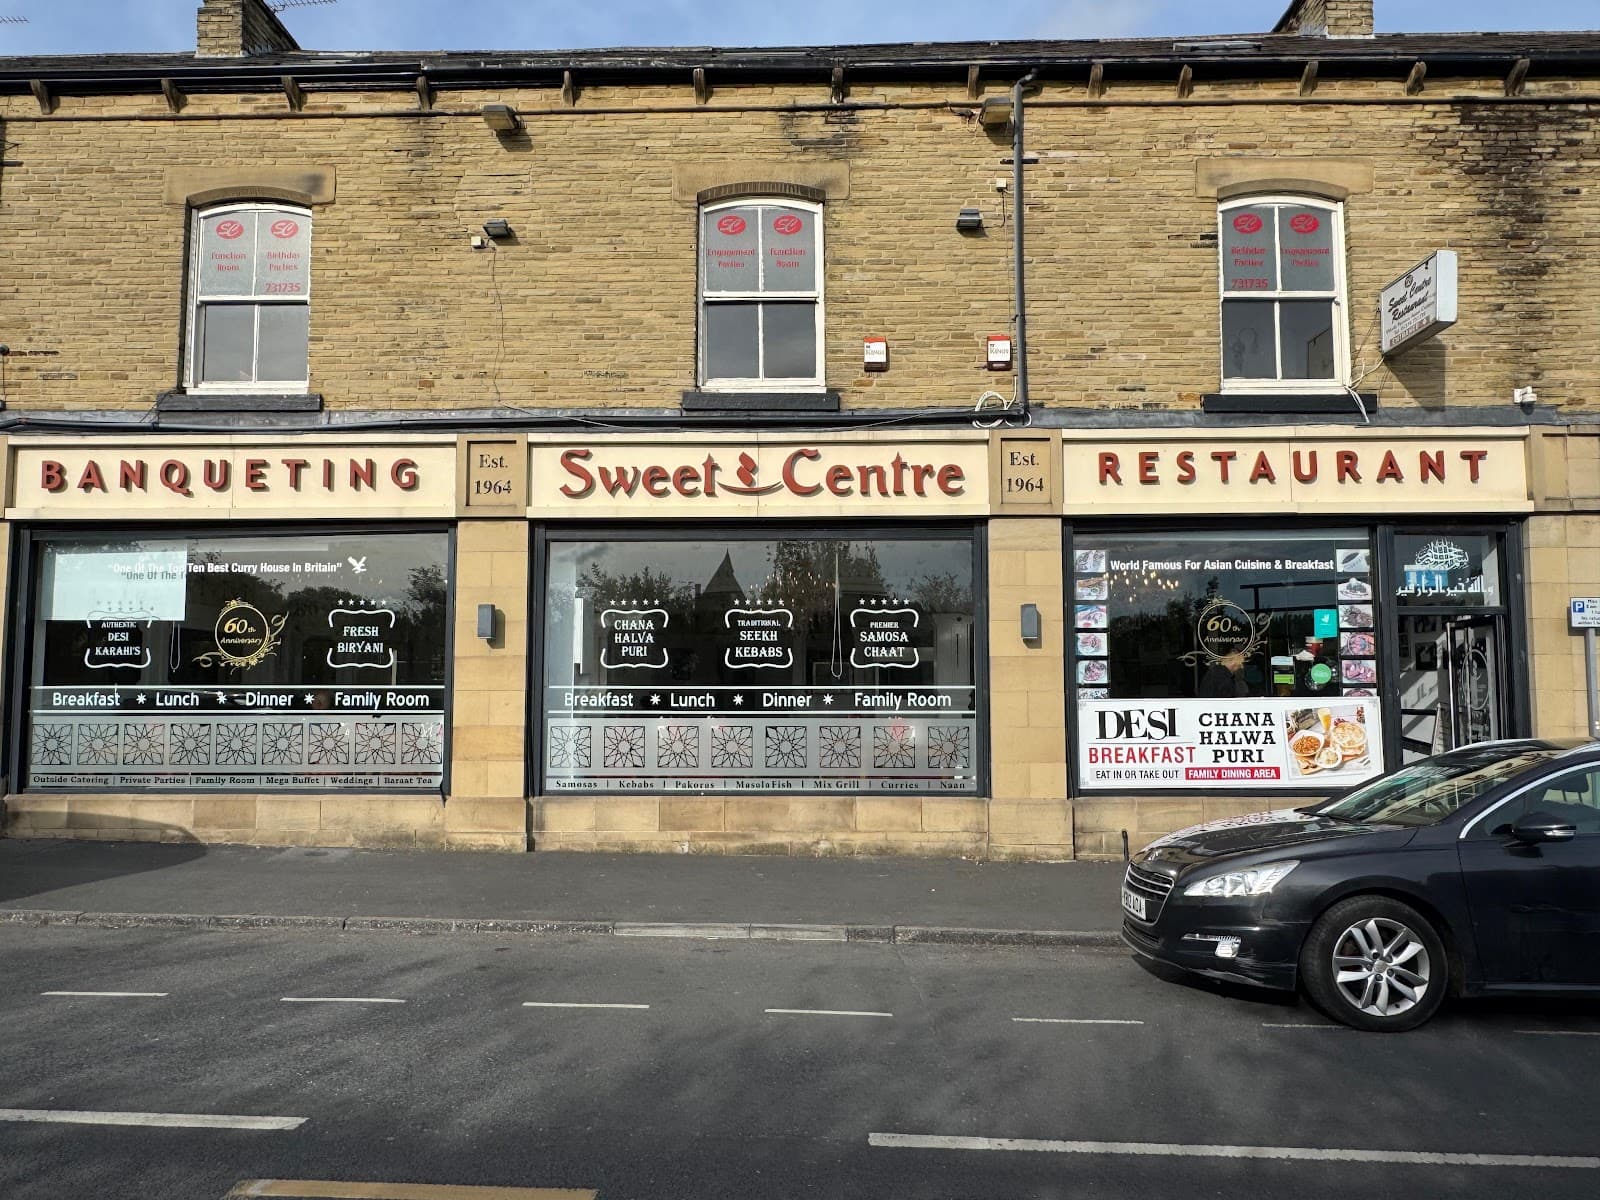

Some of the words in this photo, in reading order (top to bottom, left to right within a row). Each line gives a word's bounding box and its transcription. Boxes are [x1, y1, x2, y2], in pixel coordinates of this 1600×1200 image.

[265, 282, 301, 293] 731735
[479, 454, 509, 469] Est.
[1010, 451, 1040, 466] Est.
[559, 448, 719, 497] Sweet
[782, 448, 965, 497] Centre
[1099, 449, 1489, 485] RESTAURANT
[41, 458, 419, 496] BANQUETING
[475, 480, 512, 494] 1964
[1008, 477, 1044, 492] 1964
[187, 562, 205, 573] Ten
[207, 562, 229, 573] Best
[231, 562, 258, 575] Curry
[260, 562, 290, 573] House
[292, 562, 302, 573] In
[1110, 560, 1140, 570] World
[1142, 560, 1182, 570] Famous
[1184, 560, 1201, 570] For
[1203, 560, 1232, 570] Asian
[1234, 559, 1271, 570] Cuisine
[1273, 560, 1283, 570] &
[1285, 559, 1334, 570] Breakfast
[101, 621, 137, 629] AUTHENTIC
[614, 619, 655, 630] CHANA
[737, 619, 781, 627] TRADITIONAL
[869, 621, 900, 629] PREMIER
[107, 632, 129, 642] DESI
[343, 626, 379, 637] FRESH
[614, 630, 655, 644] HALVA
[739, 630, 778, 642] SEEKH
[859, 631, 909, 642] SAMOSA
[220, 636, 263, 646] Anniversary
[337, 640, 384, 653] BIRYANI
[1204, 636, 1248, 645] Anniversary
[621, 646, 648, 657] PURI
[735, 646, 783, 658] KEBABS
[863, 646, 905, 657] CHAAT
[52, 691, 121, 706] Breakfast
[155, 692, 200, 706] Lunch
[245, 692, 294, 706] Dinner
[334, 692, 382, 710] Family
[386, 692, 429, 706] Room
[564, 692, 633, 707] Breakfast
[670, 693, 715, 707] Lunch
[763, 693, 812, 707] Dinner
[854, 693, 902, 711] Family
[907, 693, 952, 707] Room
[1094, 707, 1179, 741] DESI
[1198, 712, 1276, 727] CHANA
[1199, 730, 1276, 746] HALWA
[1088, 746, 1196, 764] BREAKFAST
[1212, 749, 1265, 763] PURI
[1095, 770, 1111, 779] EAT
[1113, 770, 1122, 779] IN
[1124, 770, 1137, 779] OR
[1139, 770, 1160, 779] TAKE
[1162, 770, 1179, 779] OUT
[1188, 769, 1219, 779] FAMILY
[1221, 769, 1251, 779] DINING
[1253, 769, 1277, 779] AREA
[33, 775, 68, 784] Outside
[70, 775, 109, 785] Catering
[119, 776, 151, 784] Private
[154, 776, 186, 784] Parties
[195, 776, 227, 786] Family
[229, 776, 255, 784] Room
[265, 776, 289, 785] Mega
[292, 776, 320, 784] Buffet
[330, 776, 374, 785] Weddings
[416, 776, 432, 784] Tea
[555, 779, 598, 788] Samosas
[618, 780, 654, 788] Kebabs
[675, 780, 715, 789] Pakoras
[813, 780, 832, 789] Mix
[835, 780, 860, 789] Grill
[881, 780, 919, 789] Curries
[940, 781, 966, 789] Naan
